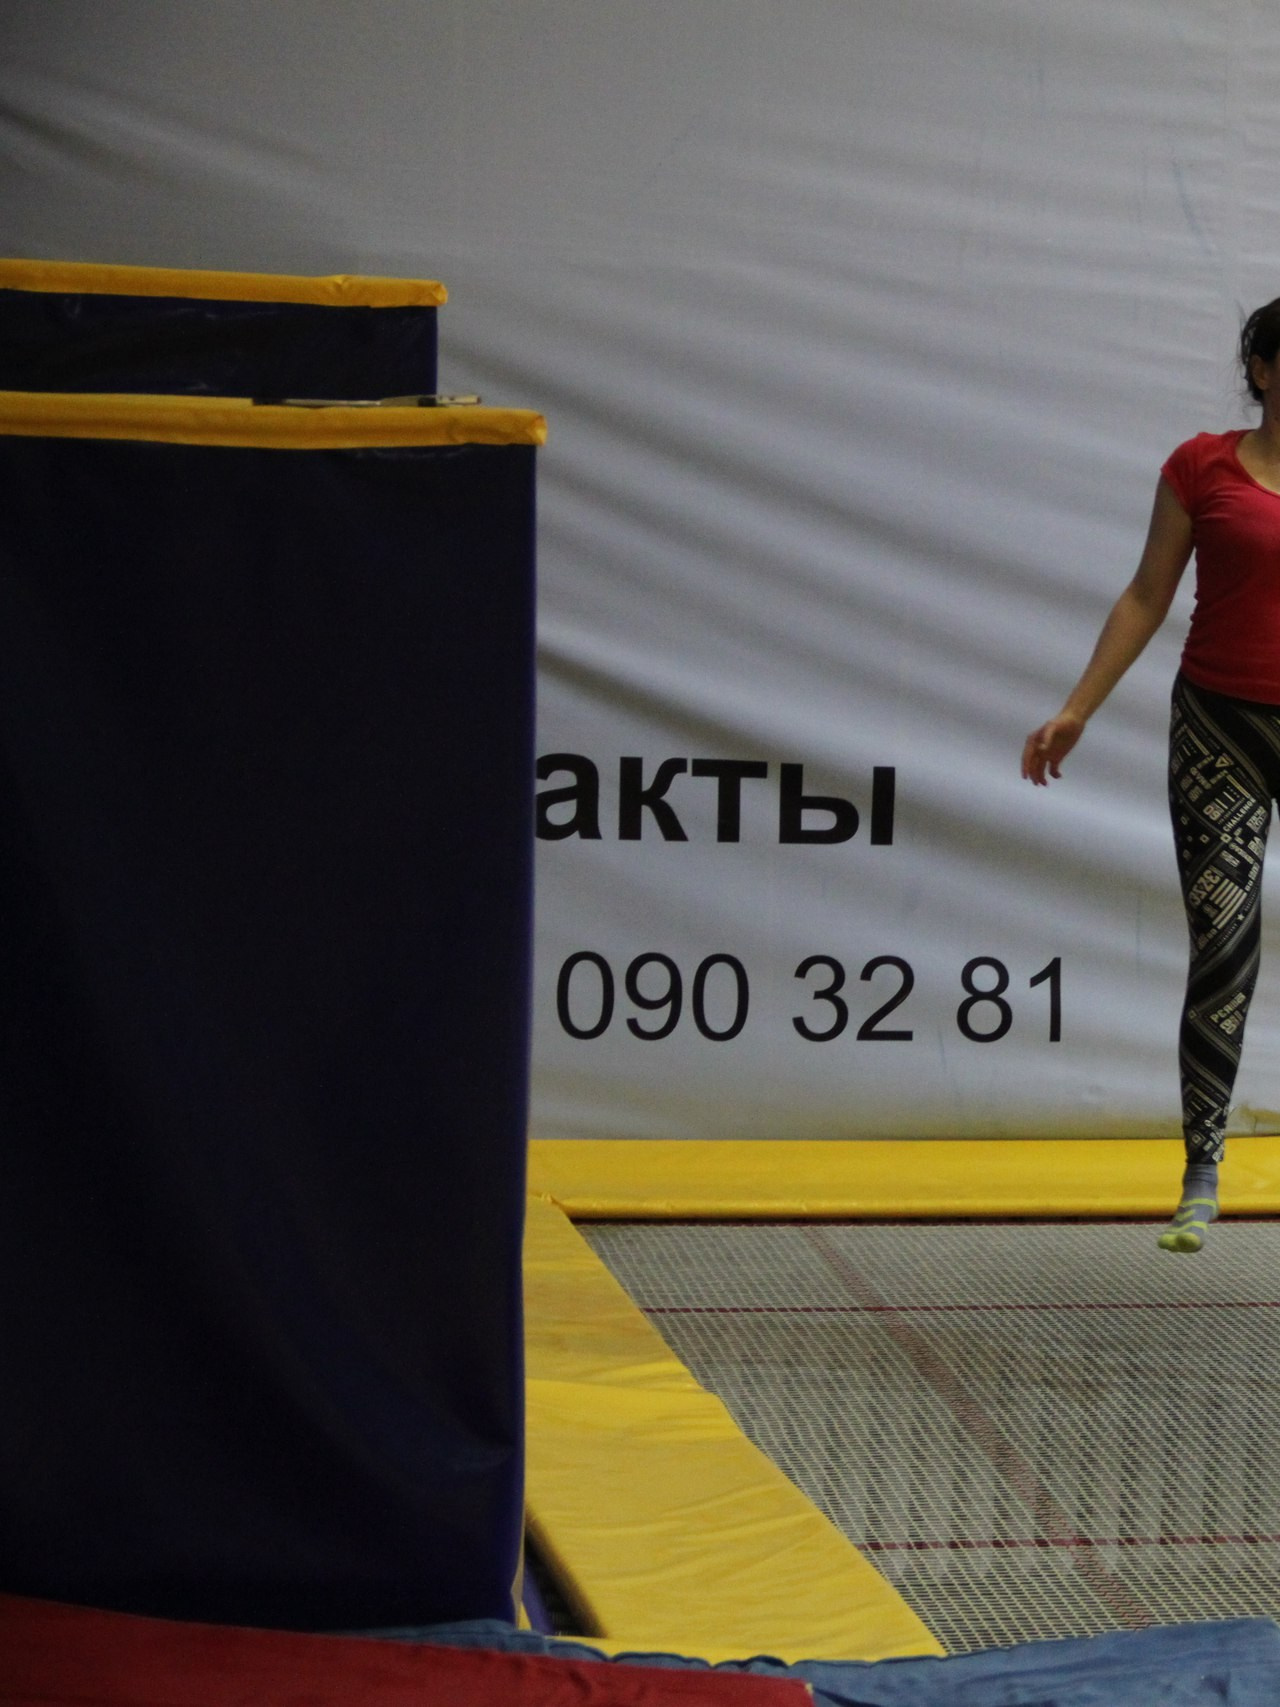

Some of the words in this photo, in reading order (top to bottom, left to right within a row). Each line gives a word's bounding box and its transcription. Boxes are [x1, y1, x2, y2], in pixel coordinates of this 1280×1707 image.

[535, 752, 896, 846] акты
[1222, 798, 1257, 832] CHALLENGE
[556, 951, 750, 1041] 090
[792, 955, 915, 1042] 32
[956, 957, 1062, 1042] 81
